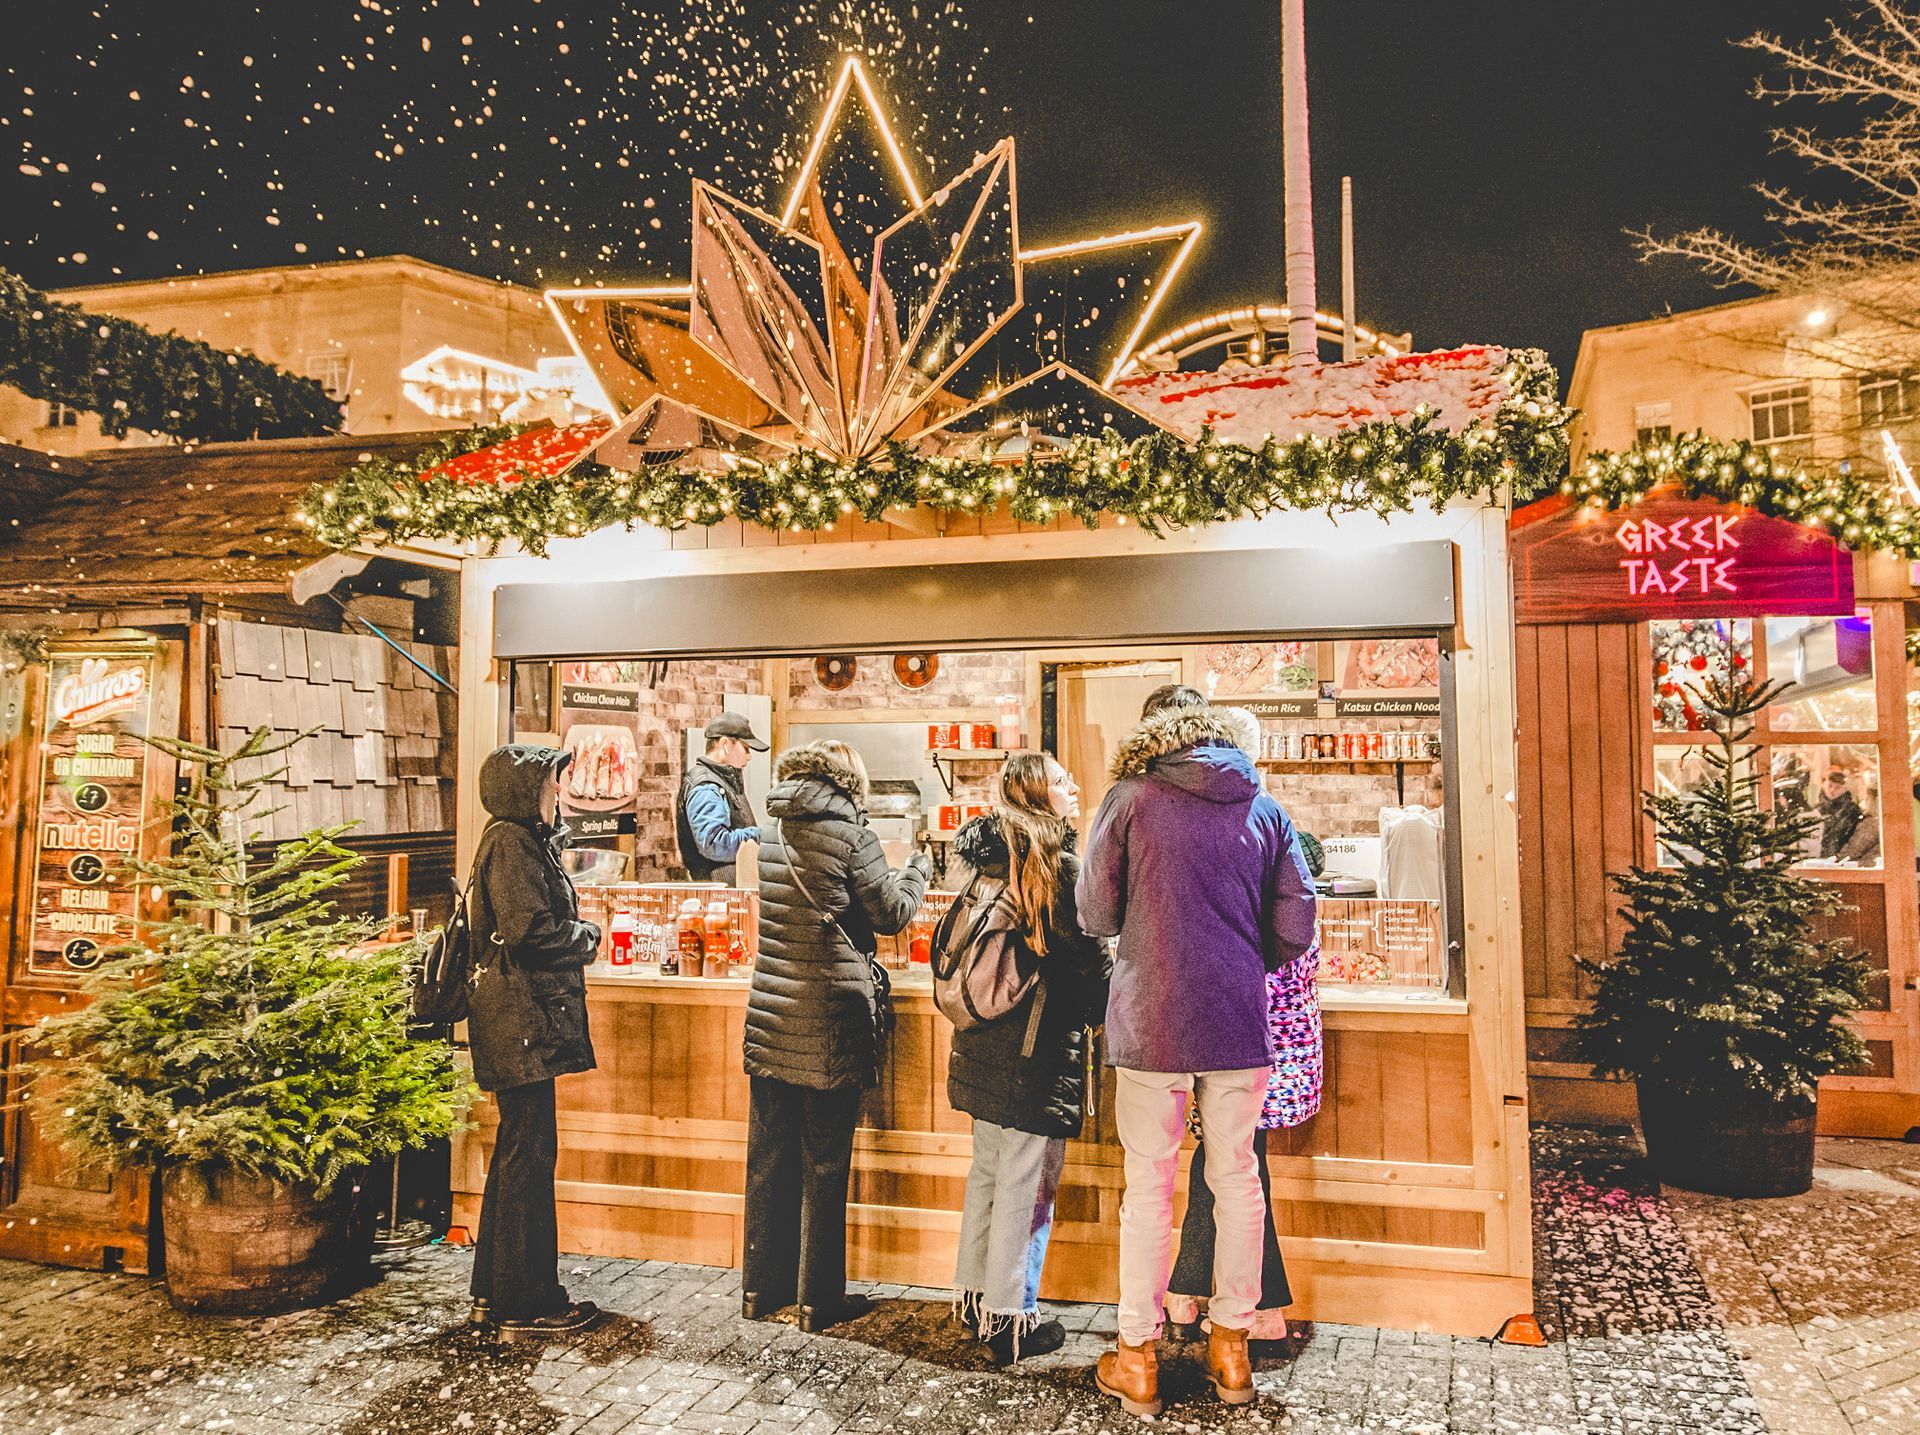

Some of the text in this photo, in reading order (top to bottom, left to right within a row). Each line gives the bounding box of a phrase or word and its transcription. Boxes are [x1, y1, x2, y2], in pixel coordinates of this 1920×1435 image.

[1615, 514, 1740, 553] GREEK
[1619, 557, 1738, 595] TASTE
[55, 667, 144, 718] Churros
[573, 692, 597, 705] Chicken
[598, 694, 615, 705] Chow
[1280, 703, 1301, 713] Rice
[1343, 702, 1372, 712] Katsu
[1373, 701, 1413, 712] Chicken
[76, 734, 115, 753] SUGAR
[54, 757, 135, 778] OR CINNAMON
[44, 819, 134, 853] nutella
[582, 819, 618, 834] Spring Rolls
[61, 889, 109, 909] BELGIAN
[616, 894, 628, 903] Veg
[51, 912, 117, 934] CHOCOLATE
